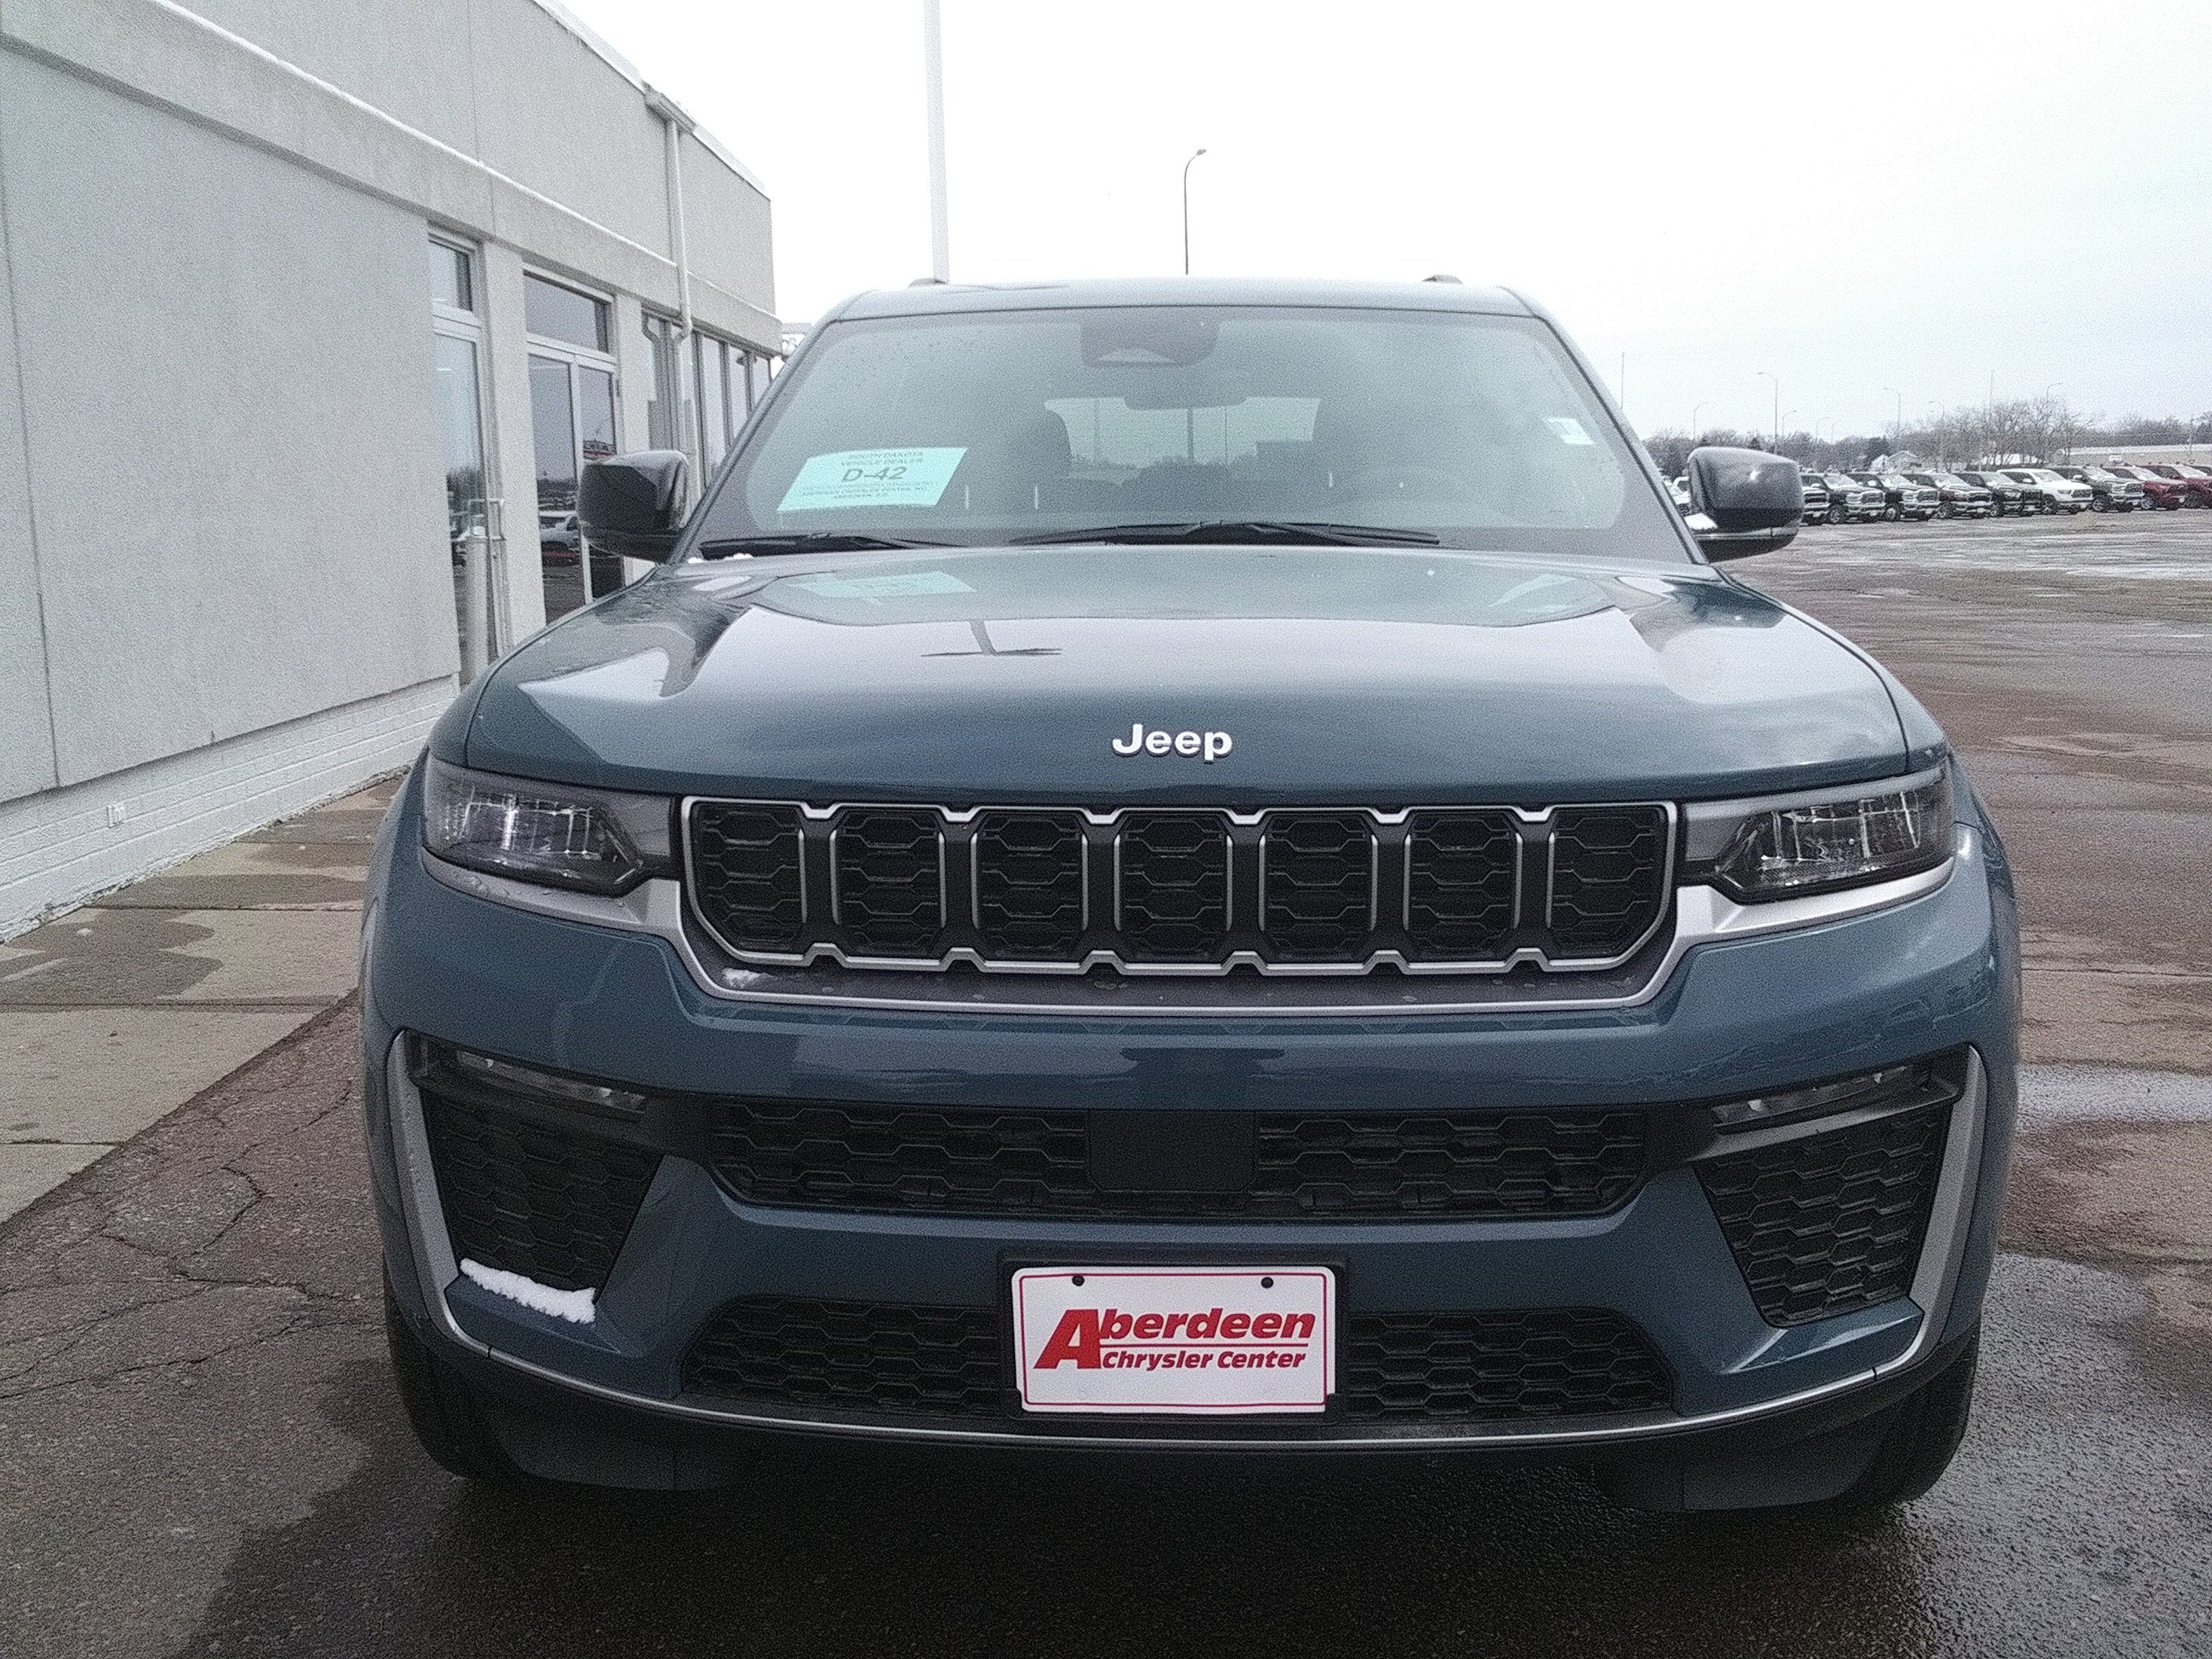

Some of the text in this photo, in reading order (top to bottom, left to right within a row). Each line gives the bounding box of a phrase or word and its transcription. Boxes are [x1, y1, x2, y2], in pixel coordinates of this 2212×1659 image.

[842, 466, 908, 482] D-42
[1112, 723, 1233, 762] Jeep
[1033, 1308, 1316, 1370] Aberdeen
[1103, 1350, 1306, 1370] Chrysler Center
